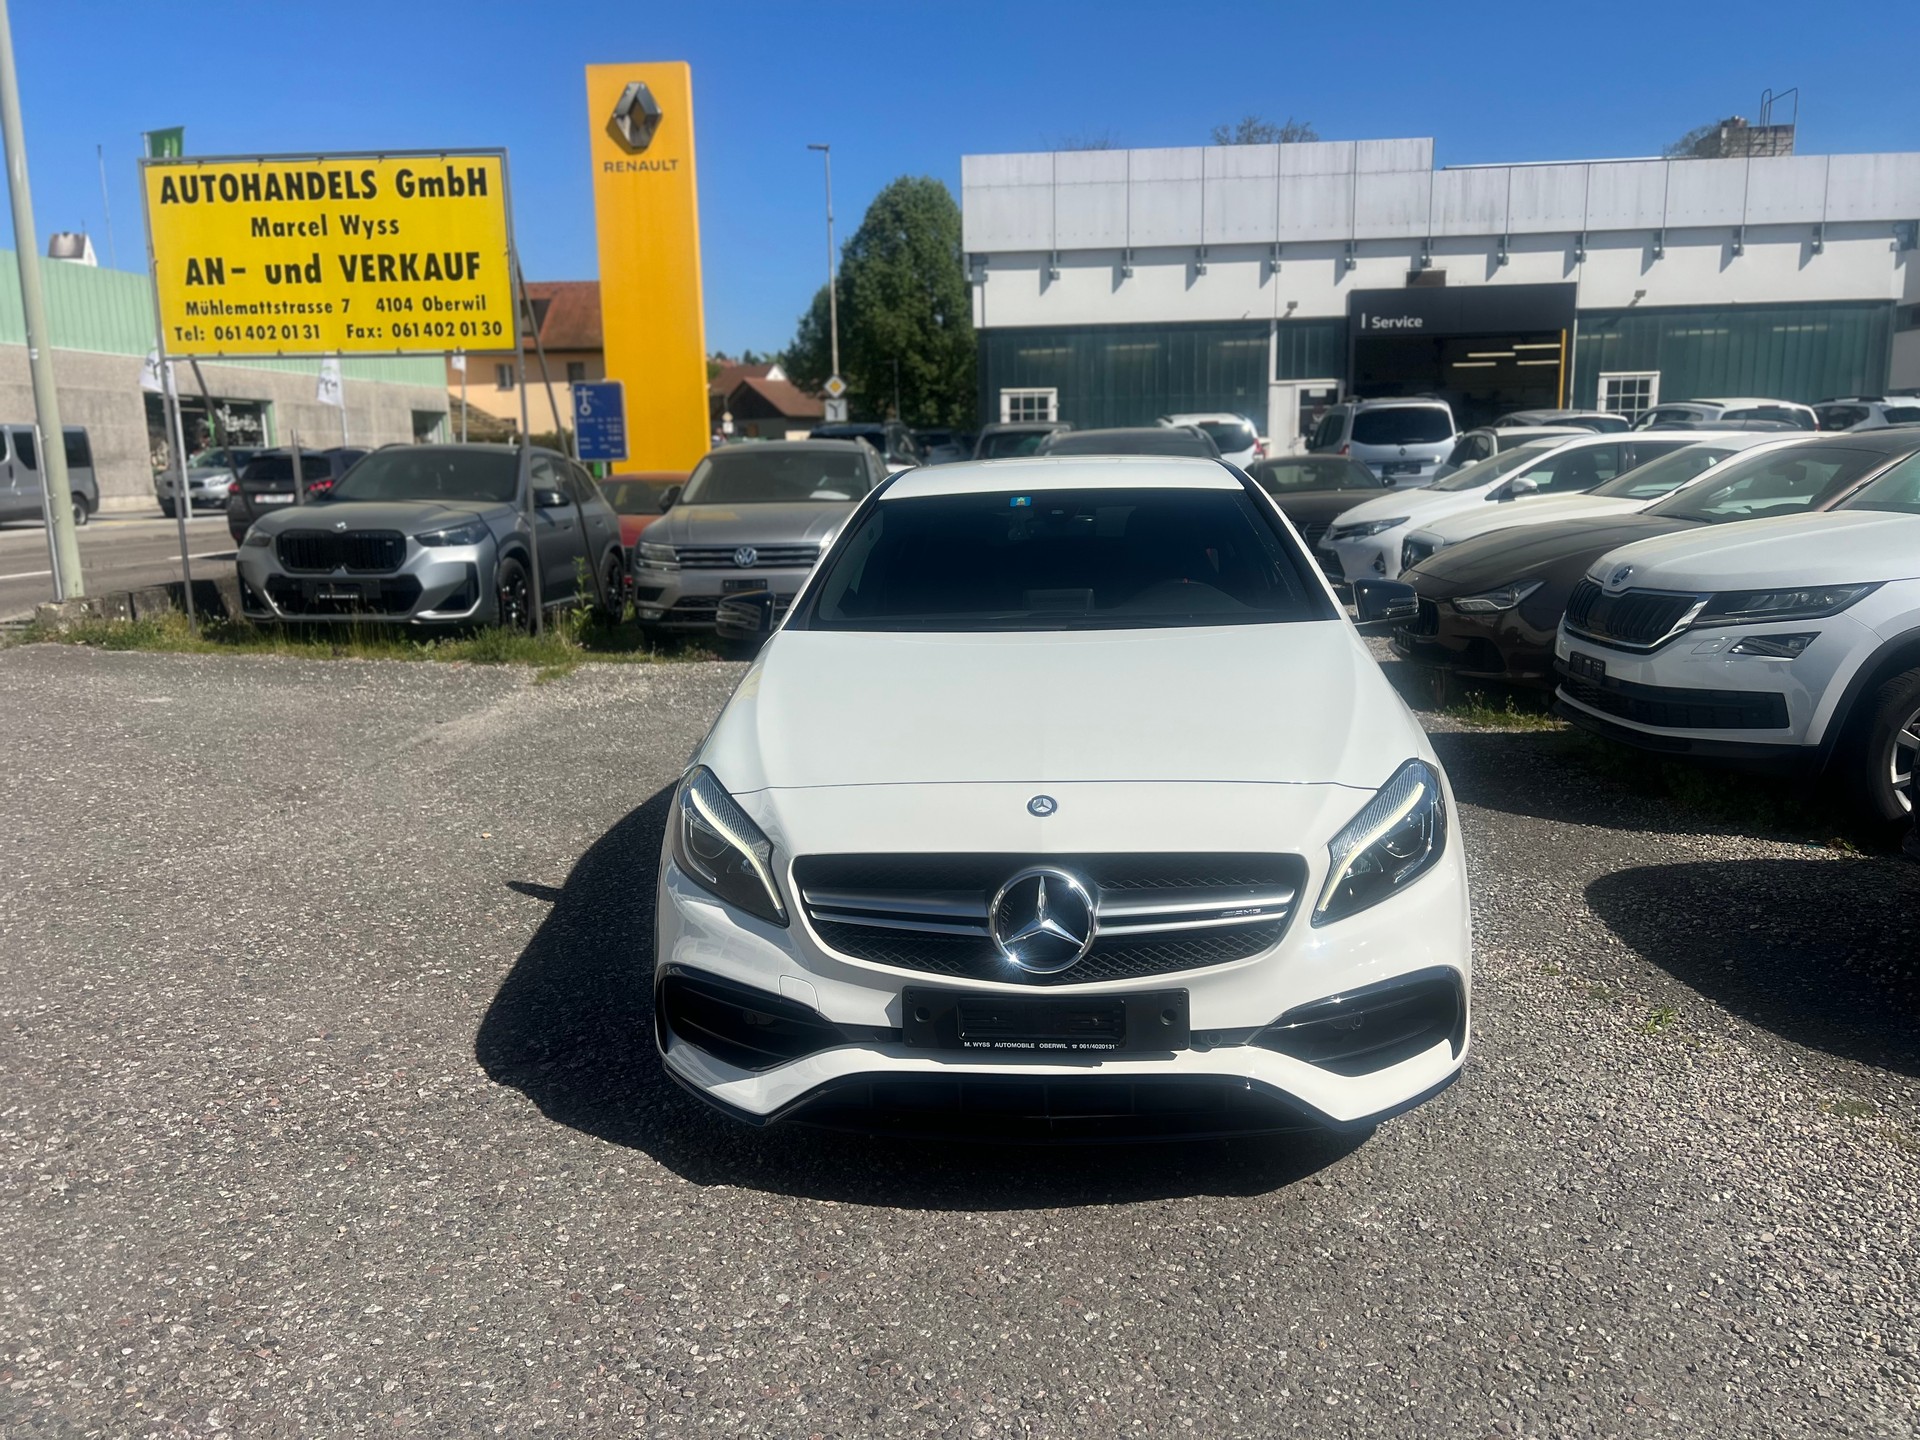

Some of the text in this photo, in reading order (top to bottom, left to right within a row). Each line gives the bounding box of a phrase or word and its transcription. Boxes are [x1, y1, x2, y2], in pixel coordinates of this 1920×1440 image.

[603, 159, 678, 173] RENAULT
[161, 165, 487, 204] AUTOHANDELS GmbH
[251, 213, 399, 240] Marcel Wyss
[264, 253, 322, 285] und
[338, 251, 480, 283] VERKAUF
[185, 294, 486, 316] Mühlemattstrasse 7 4104 Oberwil
[174, 325, 205, 341] Tel:
[346, 323, 382, 339] Fax:
[1371, 315, 1423, 329] Service
